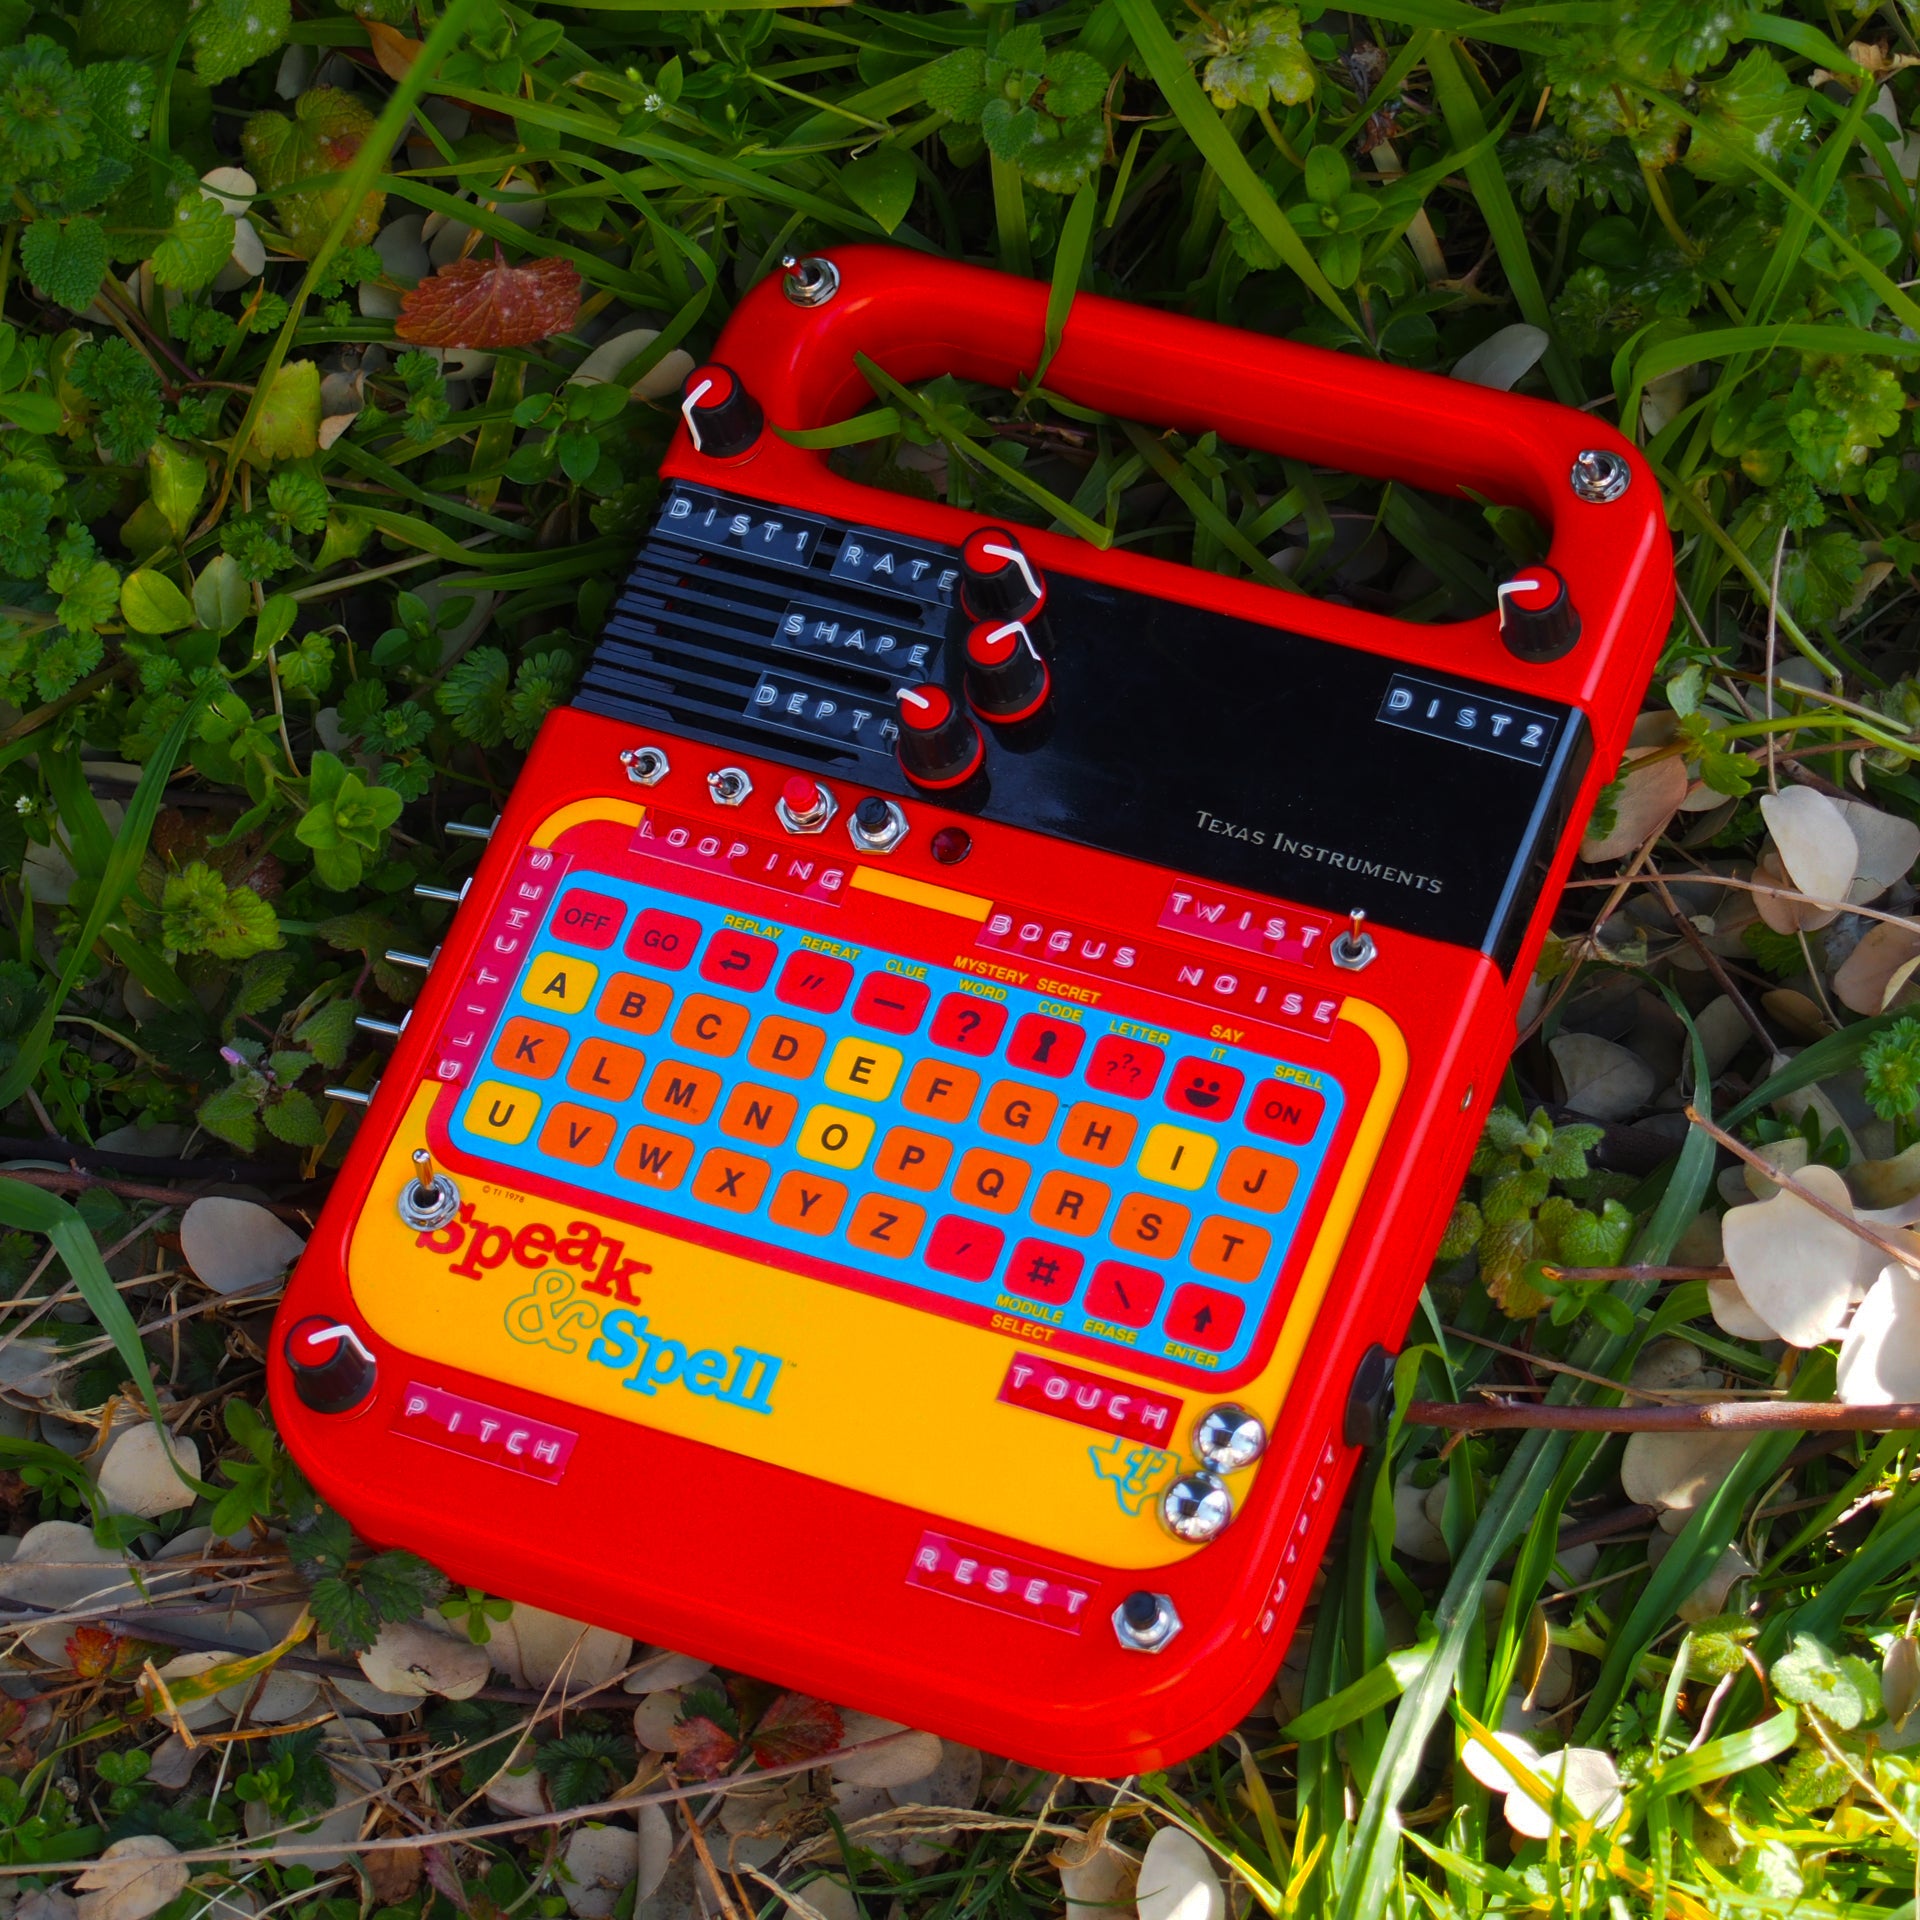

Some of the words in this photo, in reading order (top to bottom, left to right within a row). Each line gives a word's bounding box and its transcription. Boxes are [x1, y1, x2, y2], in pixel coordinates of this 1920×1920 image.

[669, 497, 809, 552] DIST1
[844, 545, 958, 592] RATE
[784, 614, 930, 667] SHAPE
[1387, 688, 1543, 748] DIST2
[639, 820, 844, 891] LOOPING
[723, 914, 783, 940] REPLAY
[1171, 892, 1322, 949] TWIST
[438, 851, 553, 1079] GLITCHES
[799, 935, 861, 962] REPEAT
[885, 958, 928, 981] CLUE
[953, 955, 1030, 985] MYSTERY
[988, 913, 1136, 968] BOGUS
[1177, 965, 1336, 1024] NOISE
[958, 978, 1007, 1002] WORD
[1036, 978, 1102, 1005] SECRET
[1037, 1000, 1084, 1023] CODE
[564, 907, 610, 932] OFF
[643, 930, 679, 952] GO
[1264, 1100, 1302, 1126] ON
[1108, 1019, 1171, 1046] LETTER
[1209, 1023, 1245, 1044] SAY
[1210, 1047, 1226, 1061] IT
[1273, 1064, 1323, 1090] SPELL
[542, 972, 567, 998] A
[619, 992, 647, 1019] B
[695, 1014, 722, 1040] C
[771, 1034, 799, 1061] D
[849, 1056, 876, 1084] E
[925, 1078, 953, 1103] F
[1004, 1100, 1032, 1128] G
[1082, 1121, 1112, 1150] H
[1170, 1145, 1185, 1171] I
[1243, 1169, 1268, 1194] J
[488, 1100, 515, 1128] U
[569, 1122, 592, 1149] V
[639, 1142, 672, 1173] W
[715, 1168, 745, 1197] X
[799, 1189, 822, 1217] Y
[870, 1212, 898, 1241] Z
[515, 1035, 544, 1064] K
[592, 1057, 612, 1085] L
[664, 1077, 697, 1109] M
[743, 1101, 773, 1130] N
[820, 1124, 848, 1151] O
[898, 1145, 925, 1172] P
[976, 1168, 1005, 1198] Q
[1055, 1189, 1084, 1220] R
[1136, 1213, 1163, 1241] S
[1222, 1234, 1244, 1262] T
[990, 1314, 1055, 1341] SELECT
[995, 1293, 1064, 1324] MODULE
[1083, 1319, 1138, 1344] ERASE
[504, 1268, 599, 1354] &
[587, 1308, 782, 1414] Spell
[1163, 1342, 1219, 1368] ENTER
[1010, 1364, 1168, 1430] TOUCH
[405, 1397, 560, 1464] PITCH
[914, 1545, 1087, 1614] RESET
